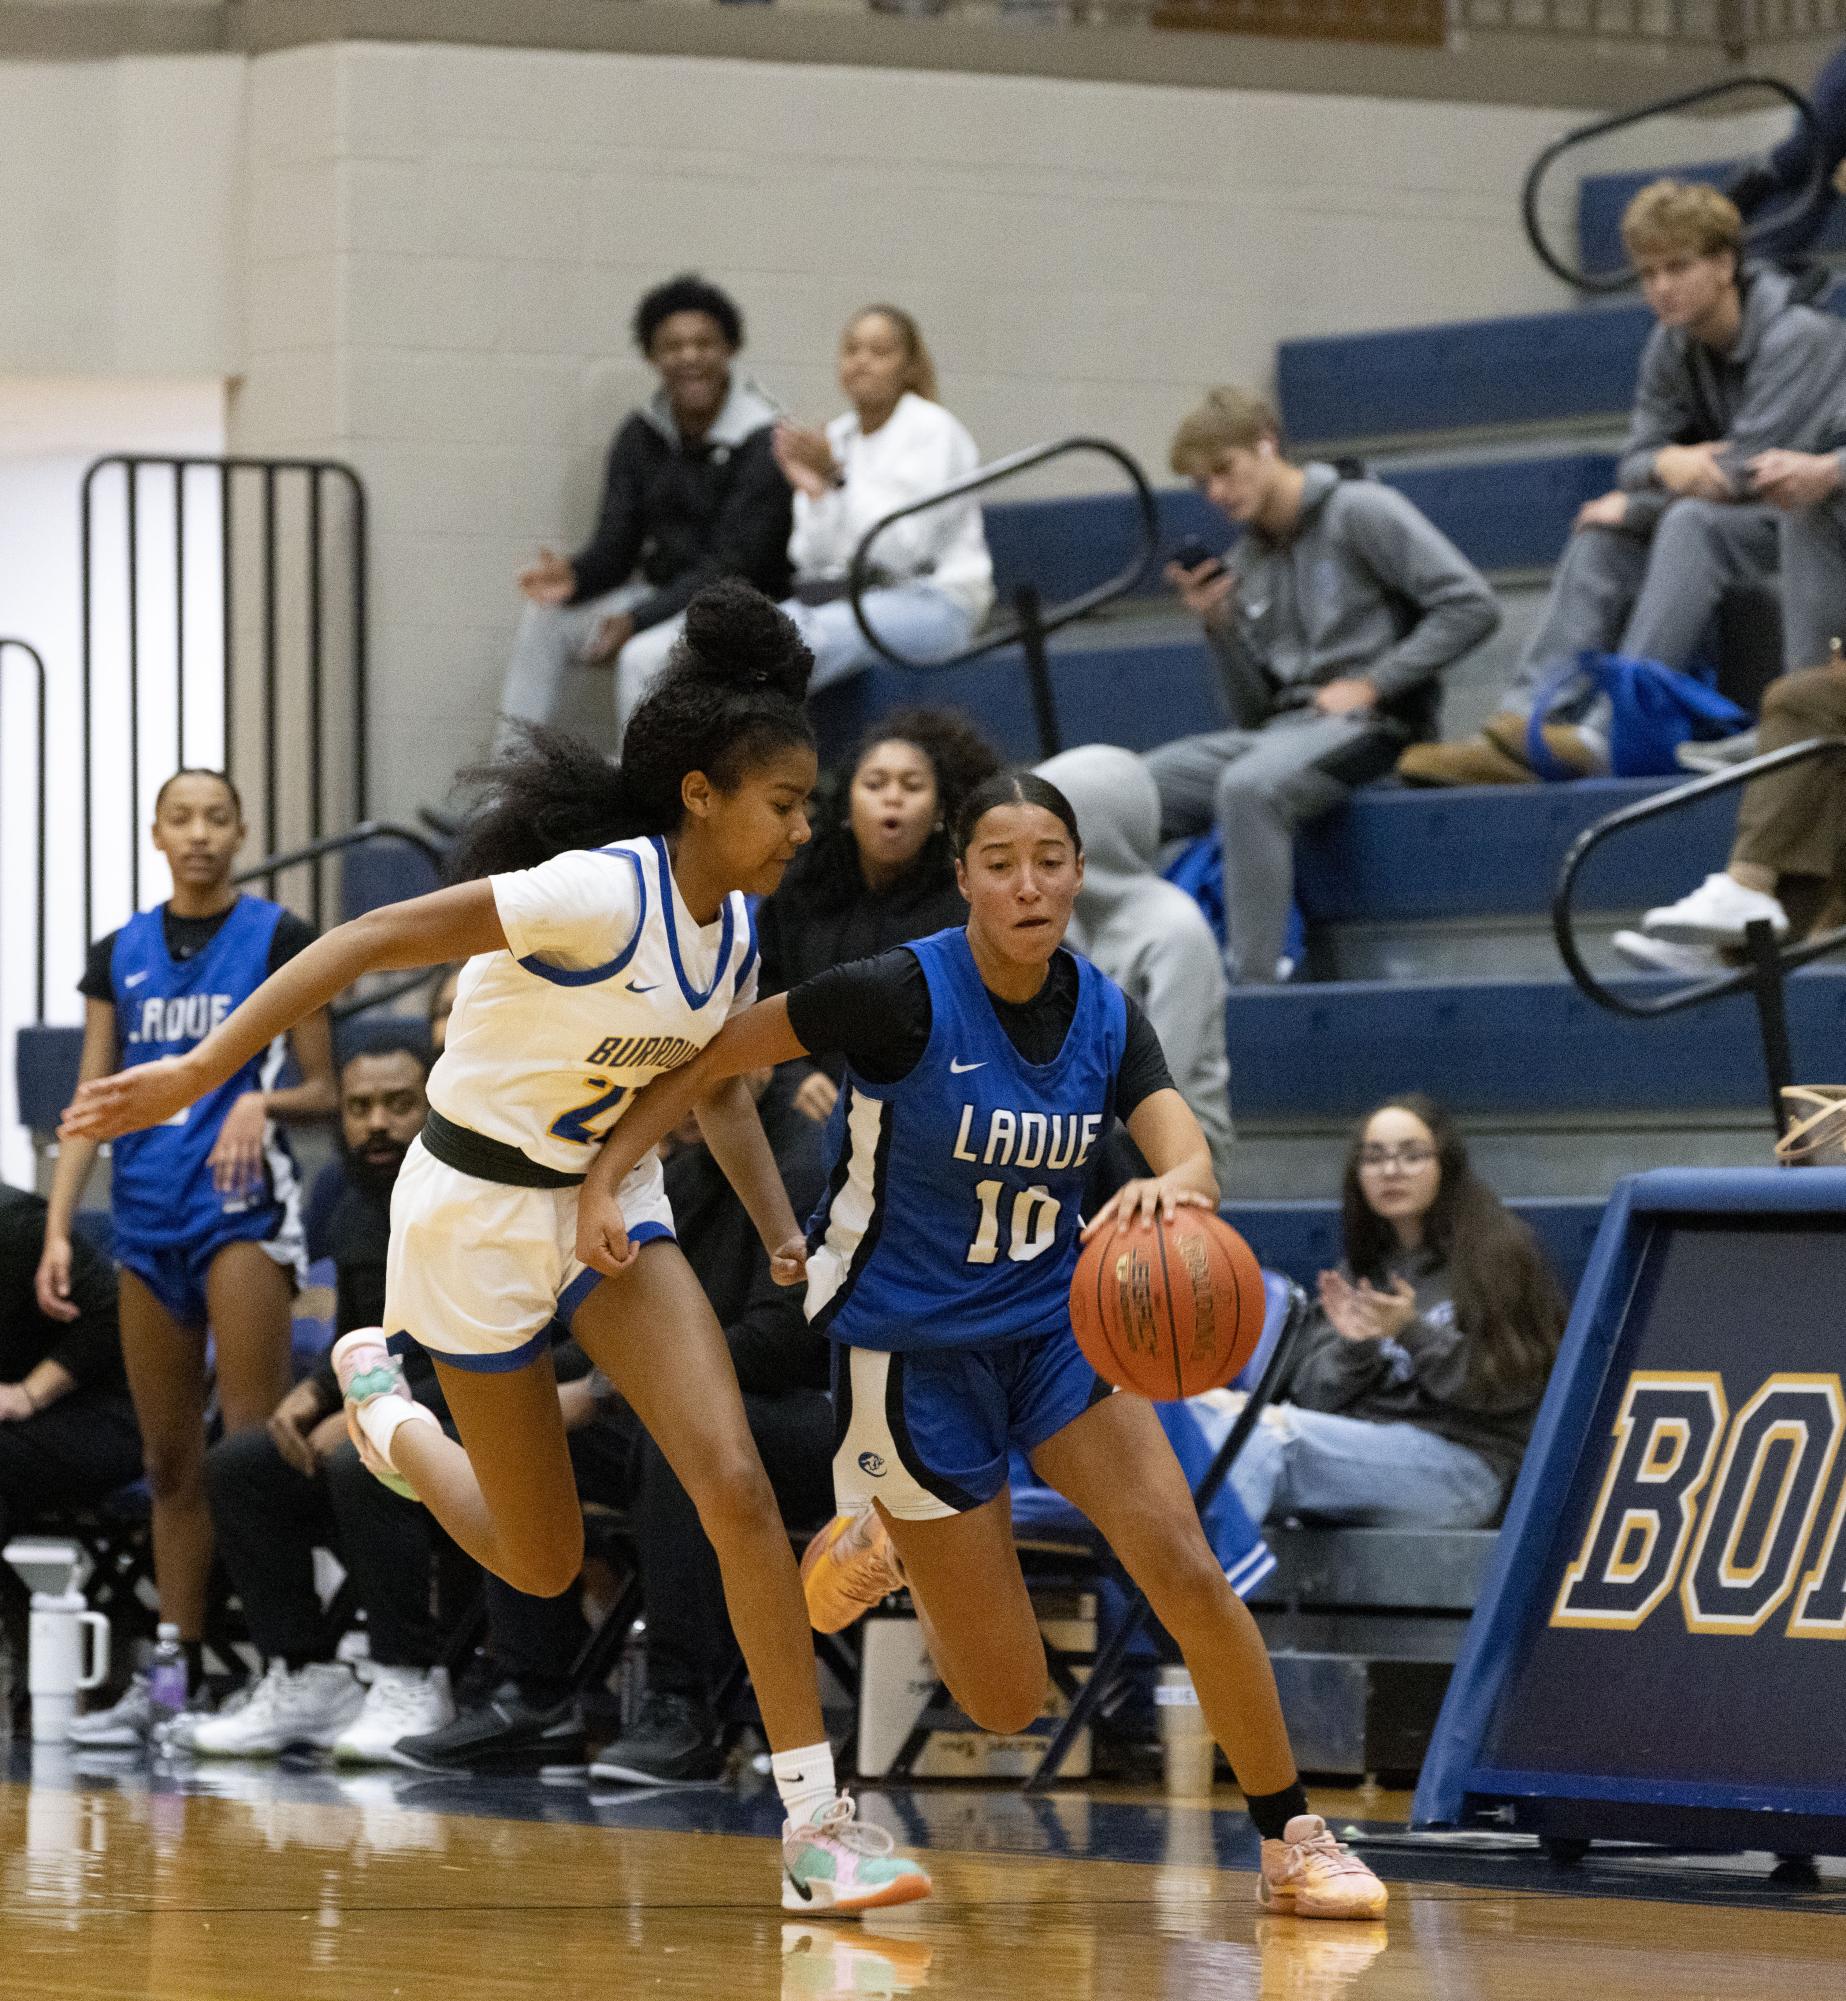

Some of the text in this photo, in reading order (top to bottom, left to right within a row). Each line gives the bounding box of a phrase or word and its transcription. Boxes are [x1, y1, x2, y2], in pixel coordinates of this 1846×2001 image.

[584, 1035, 701, 1069] BURROU
[546, 1074, 642, 1146] 2
[953, 1104, 1102, 1170] LADUE
[967, 1179, 1061, 1264] 10
